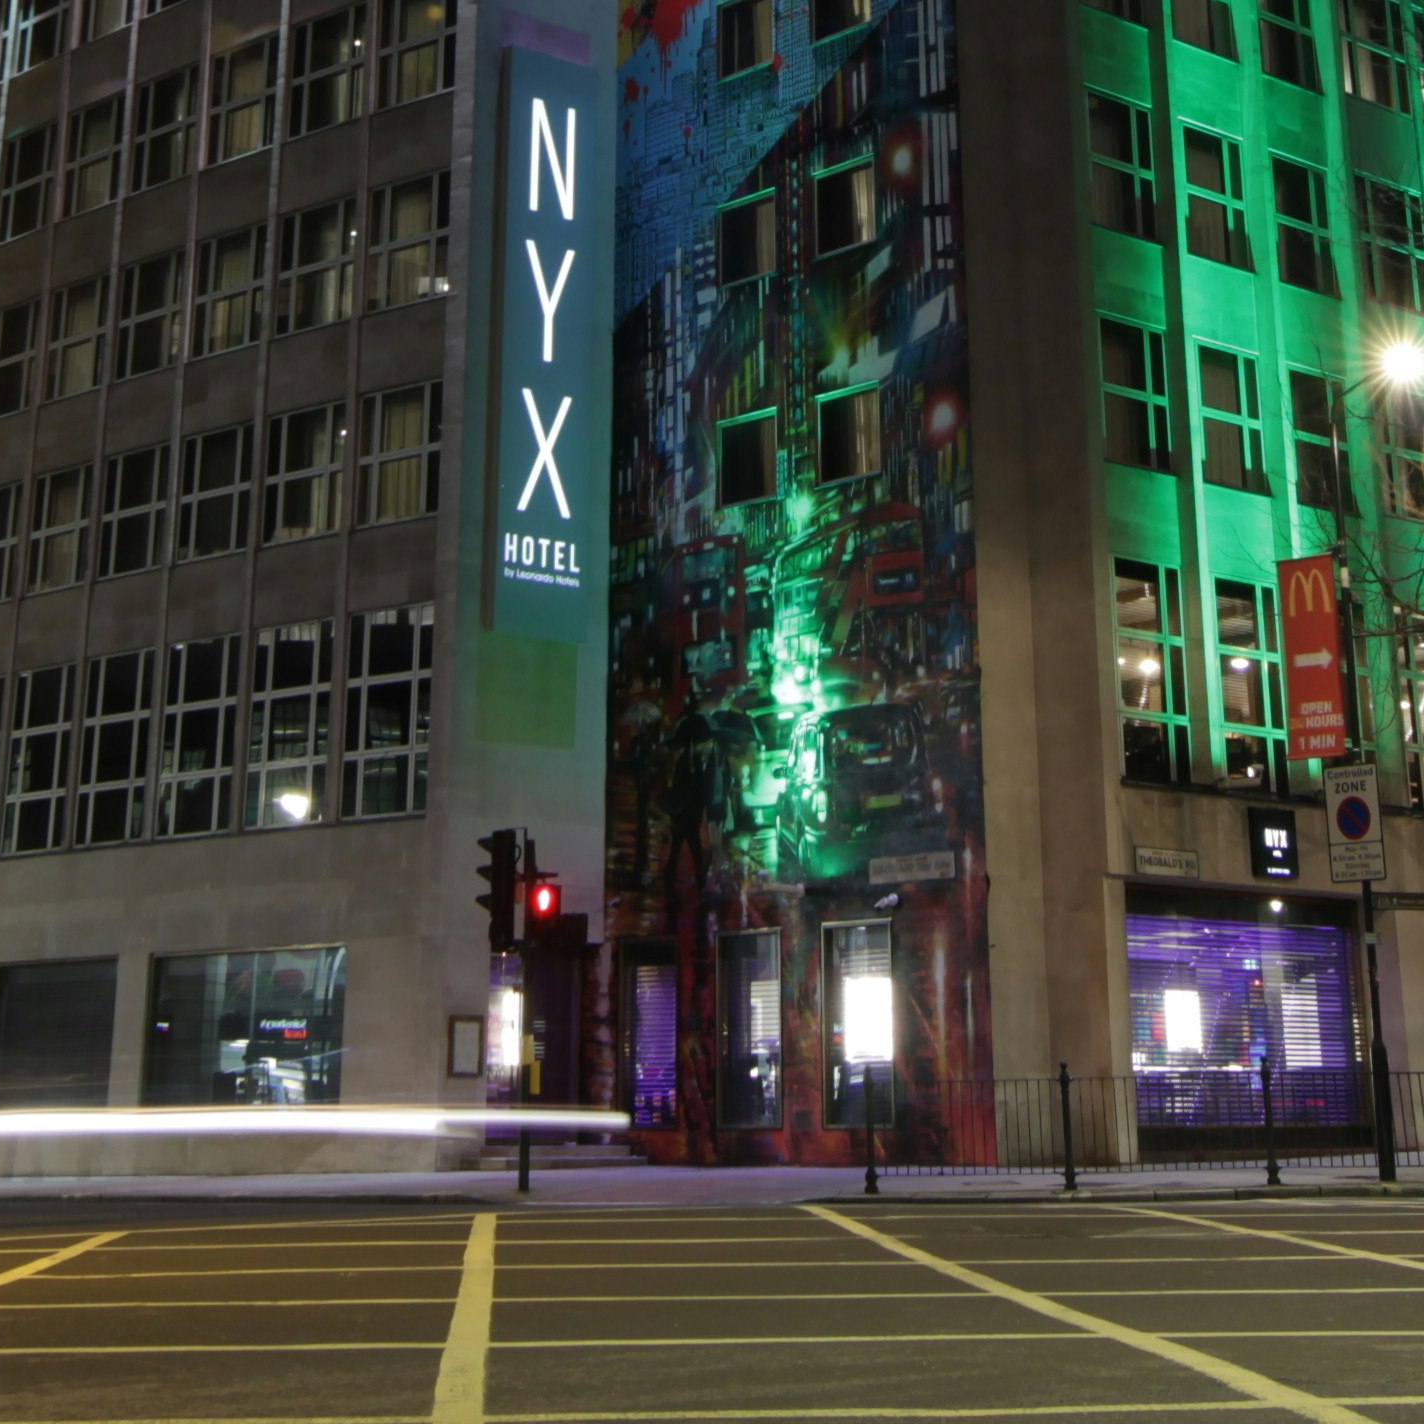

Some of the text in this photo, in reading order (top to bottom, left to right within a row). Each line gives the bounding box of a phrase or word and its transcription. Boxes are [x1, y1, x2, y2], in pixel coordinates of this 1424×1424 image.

[516, 96, 576, 518] NYX
[503, 532, 580, 574] HOTEL
[1300, 701, 1333, 715] OPEN
[1305, 713, 1345, 728] HOURS
[1310, 734, 1336, 749] MIN
[1327, 767, 1374, 779] Controlled
[1334, 780, 1367, 794] ZONE
